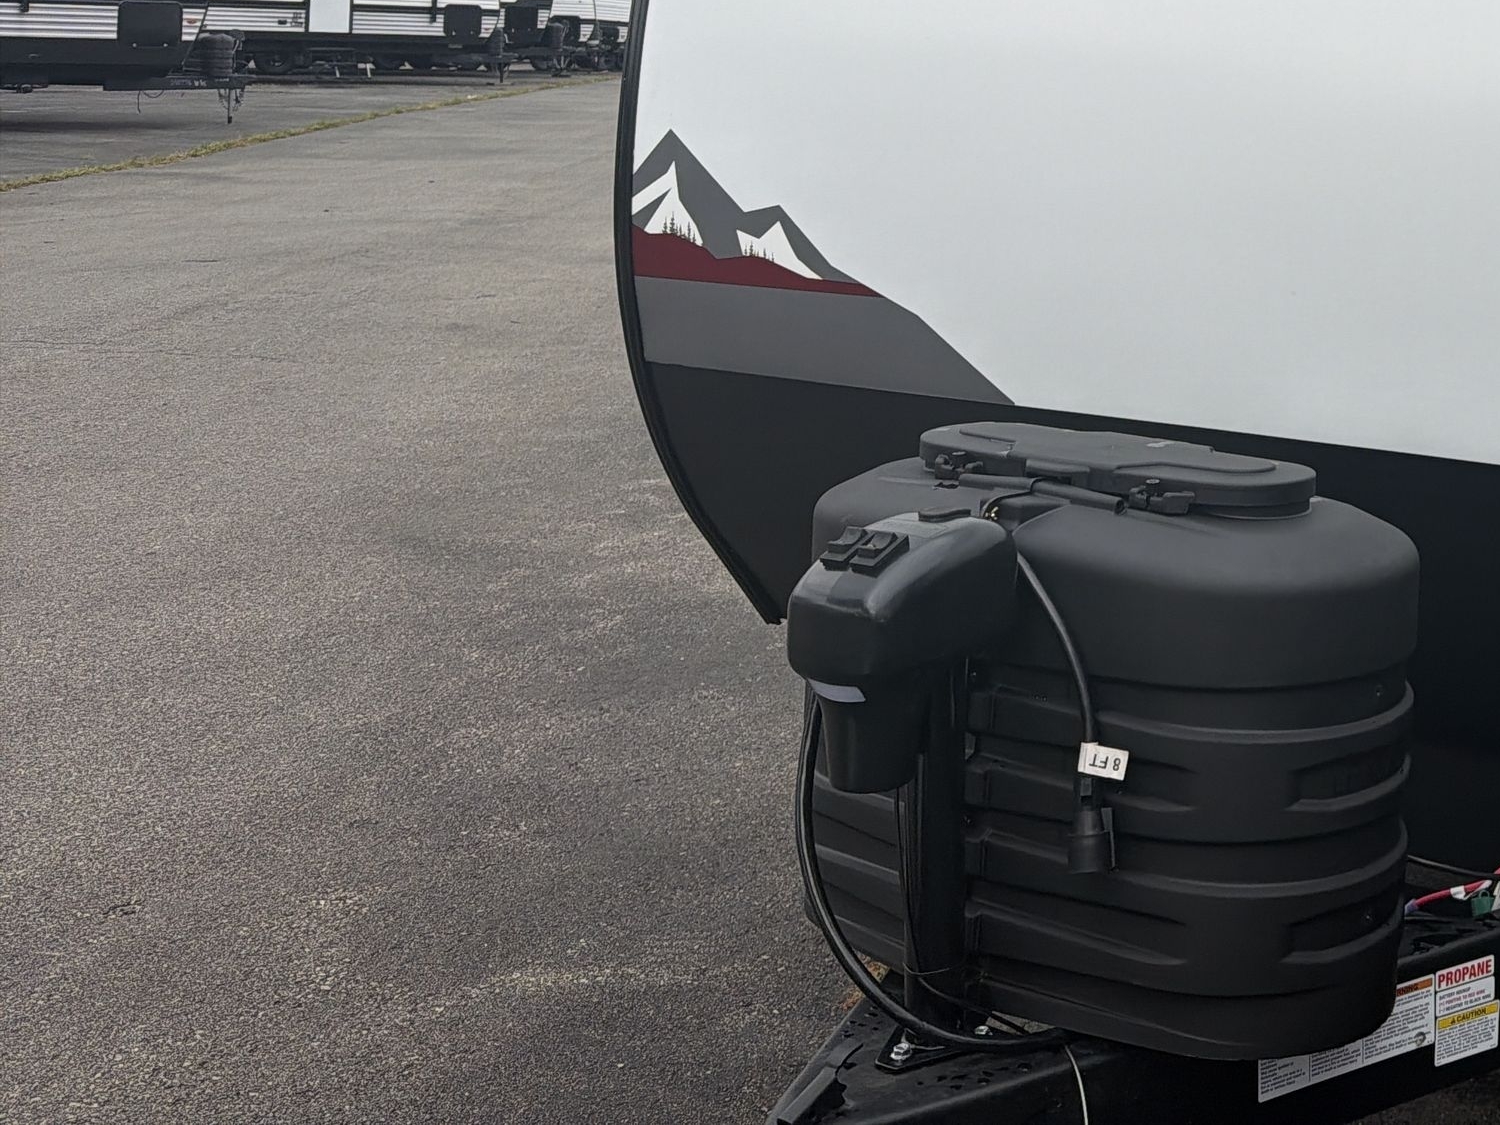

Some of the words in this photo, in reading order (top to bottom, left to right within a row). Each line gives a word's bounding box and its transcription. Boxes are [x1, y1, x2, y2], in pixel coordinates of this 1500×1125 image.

[1088, 753, 1109, 769] FT
[1112, 757, 1121, 771] 8
[1438, 959, 1492, 988] PROPANE
[1396, 983, 1418, 997] RNING
[1457, 1007, 1486, 1023] CAUTION
